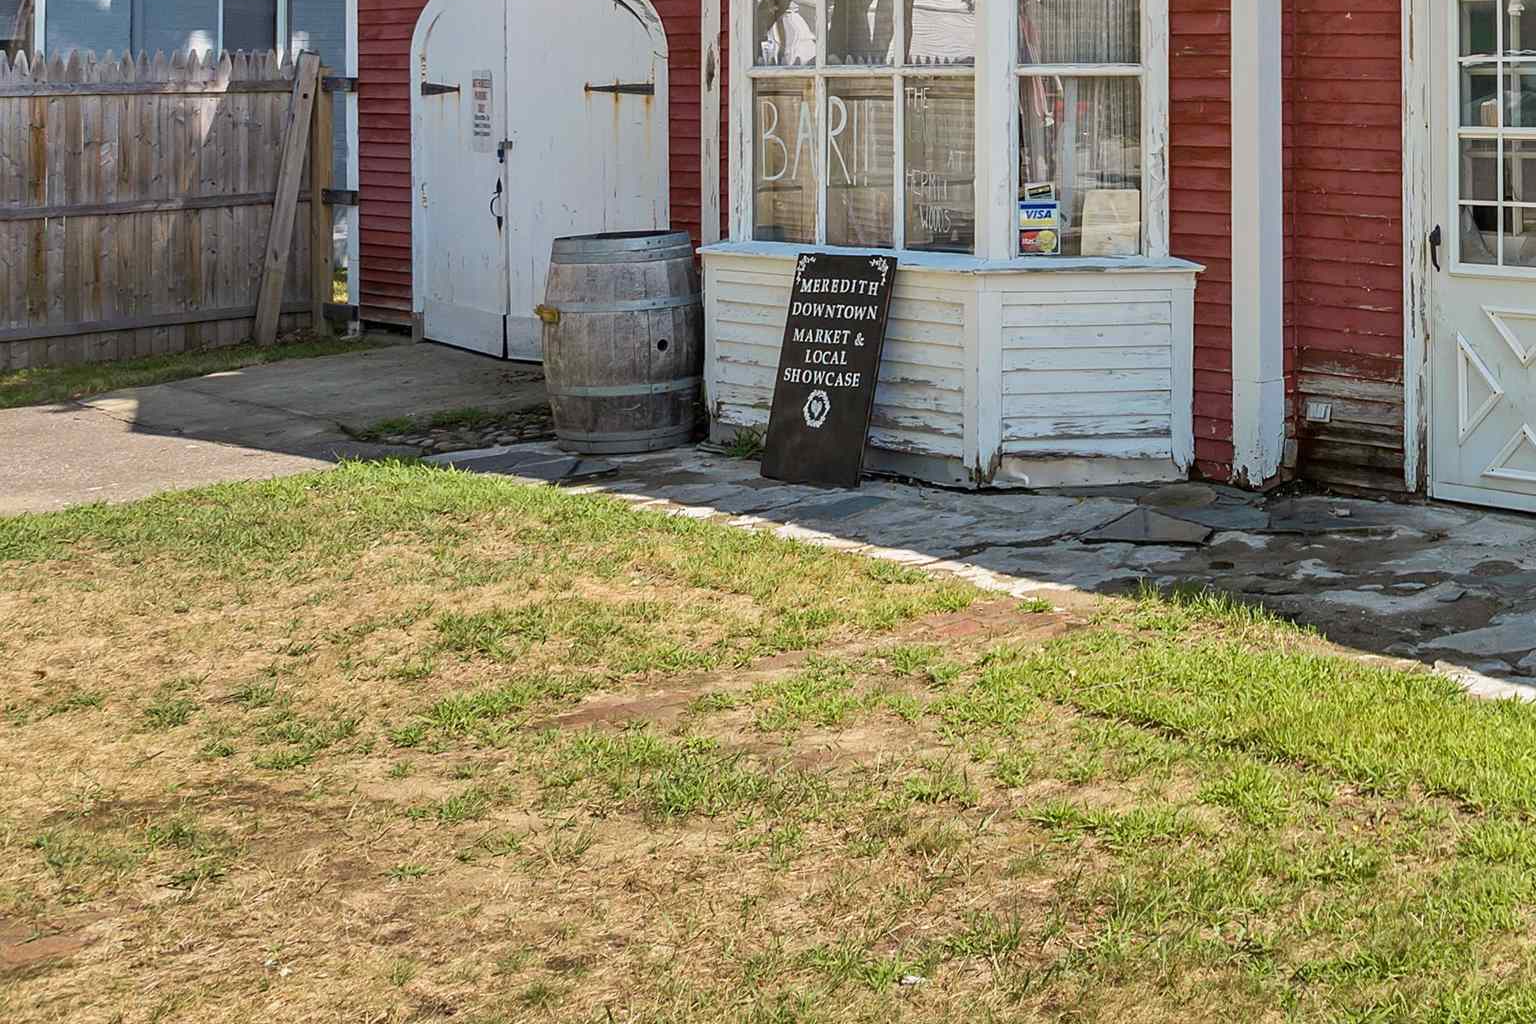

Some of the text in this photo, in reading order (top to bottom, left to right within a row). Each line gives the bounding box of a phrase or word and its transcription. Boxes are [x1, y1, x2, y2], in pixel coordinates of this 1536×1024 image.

[905, 87, 930, 110] THE
[1025, 210, 1052, 219] VISA
[800, 278, 879, 296] MEREDITH
[792, 302, 878, 321] DOWNTOWN
[793, 328, 865, 346] MARKET &
[804, 349, 848, 365] LOCAL
[783, 367, 861, 388] SHOWCASE
